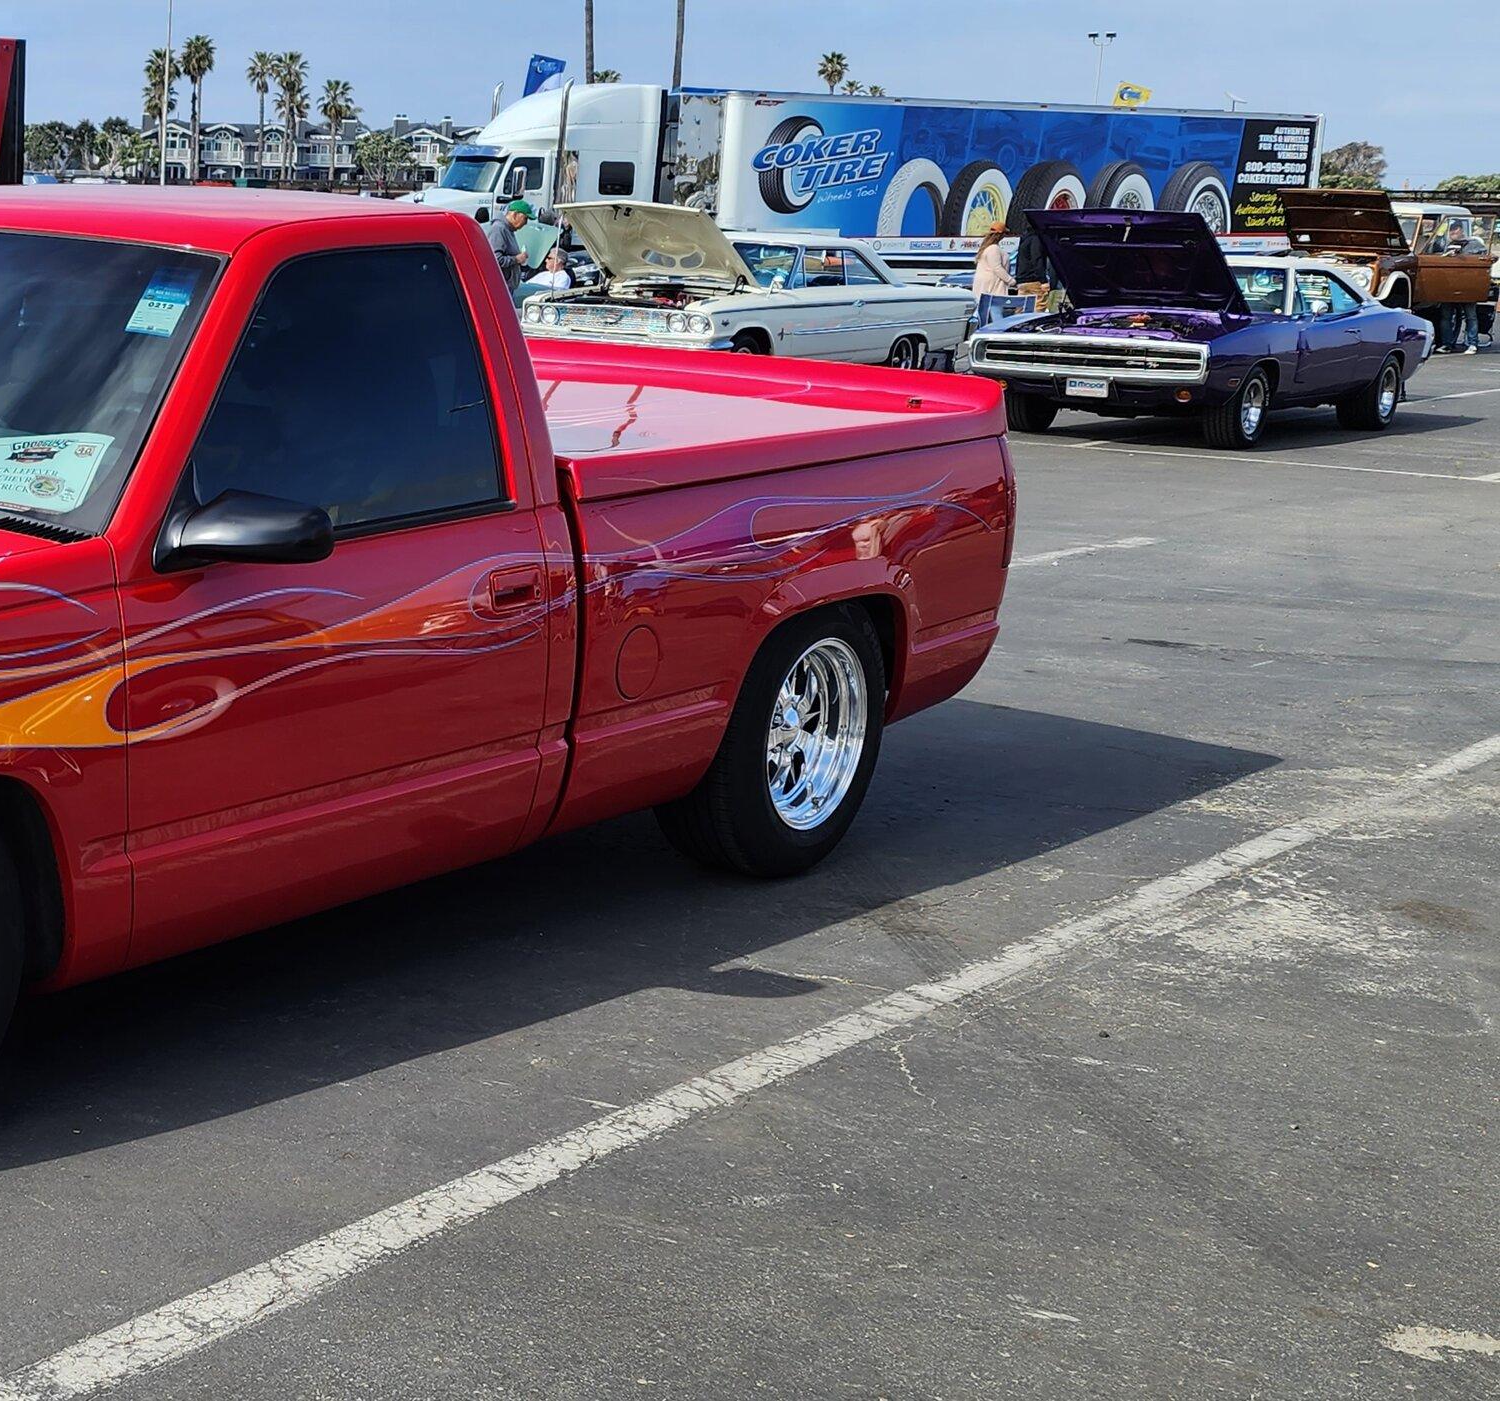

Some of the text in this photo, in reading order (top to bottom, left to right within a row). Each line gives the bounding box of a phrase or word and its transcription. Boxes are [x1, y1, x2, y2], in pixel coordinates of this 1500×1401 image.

[1274, 127, 1311, 136] AUTHENTIC
[1258, 134, 1277, 143] TIRES
[1284, 136, 1310, 144] WHEELS
[752, 128, 882, 172] COKER
[1258, 142, 1309, 152] FOR COLLECTOR
[1277, 151, 1308, 160] VEHICLES
[797, 150, 893, 193] TIRE
[1245, 162, 1307, 173] 800-959-5600
[1237, 173, 1306, 185] COKERTIRE.COM
[856, 184, 879, 198] Too!
[148, 301, 174, 310] 0212
